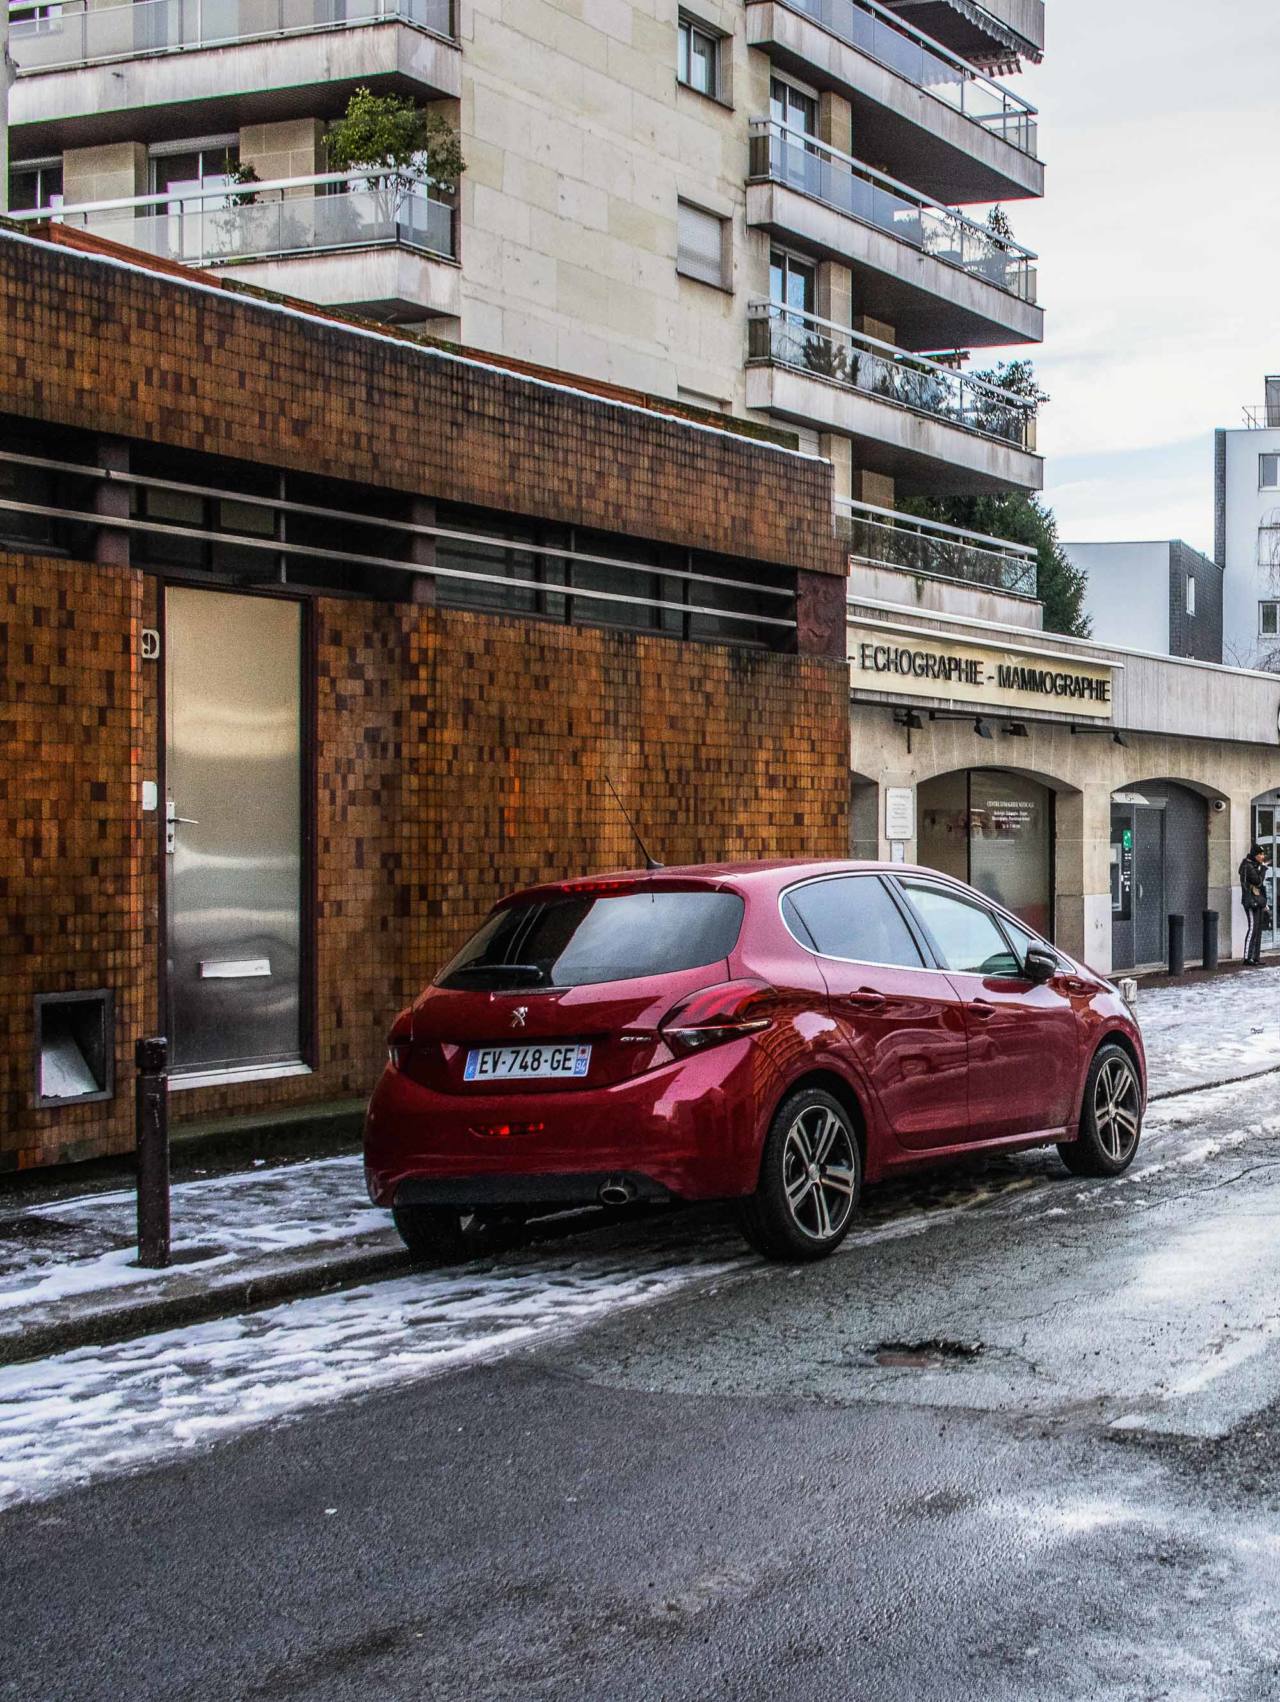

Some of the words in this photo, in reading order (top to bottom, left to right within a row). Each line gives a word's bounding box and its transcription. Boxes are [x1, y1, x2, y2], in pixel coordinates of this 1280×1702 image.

[861, 643, 985, 686] ECHOGRAPHIE
[998, 664, 1110, 702] MAMMOGRAPHIE
[478, 1047, 575, 1074] EV-748-GE
